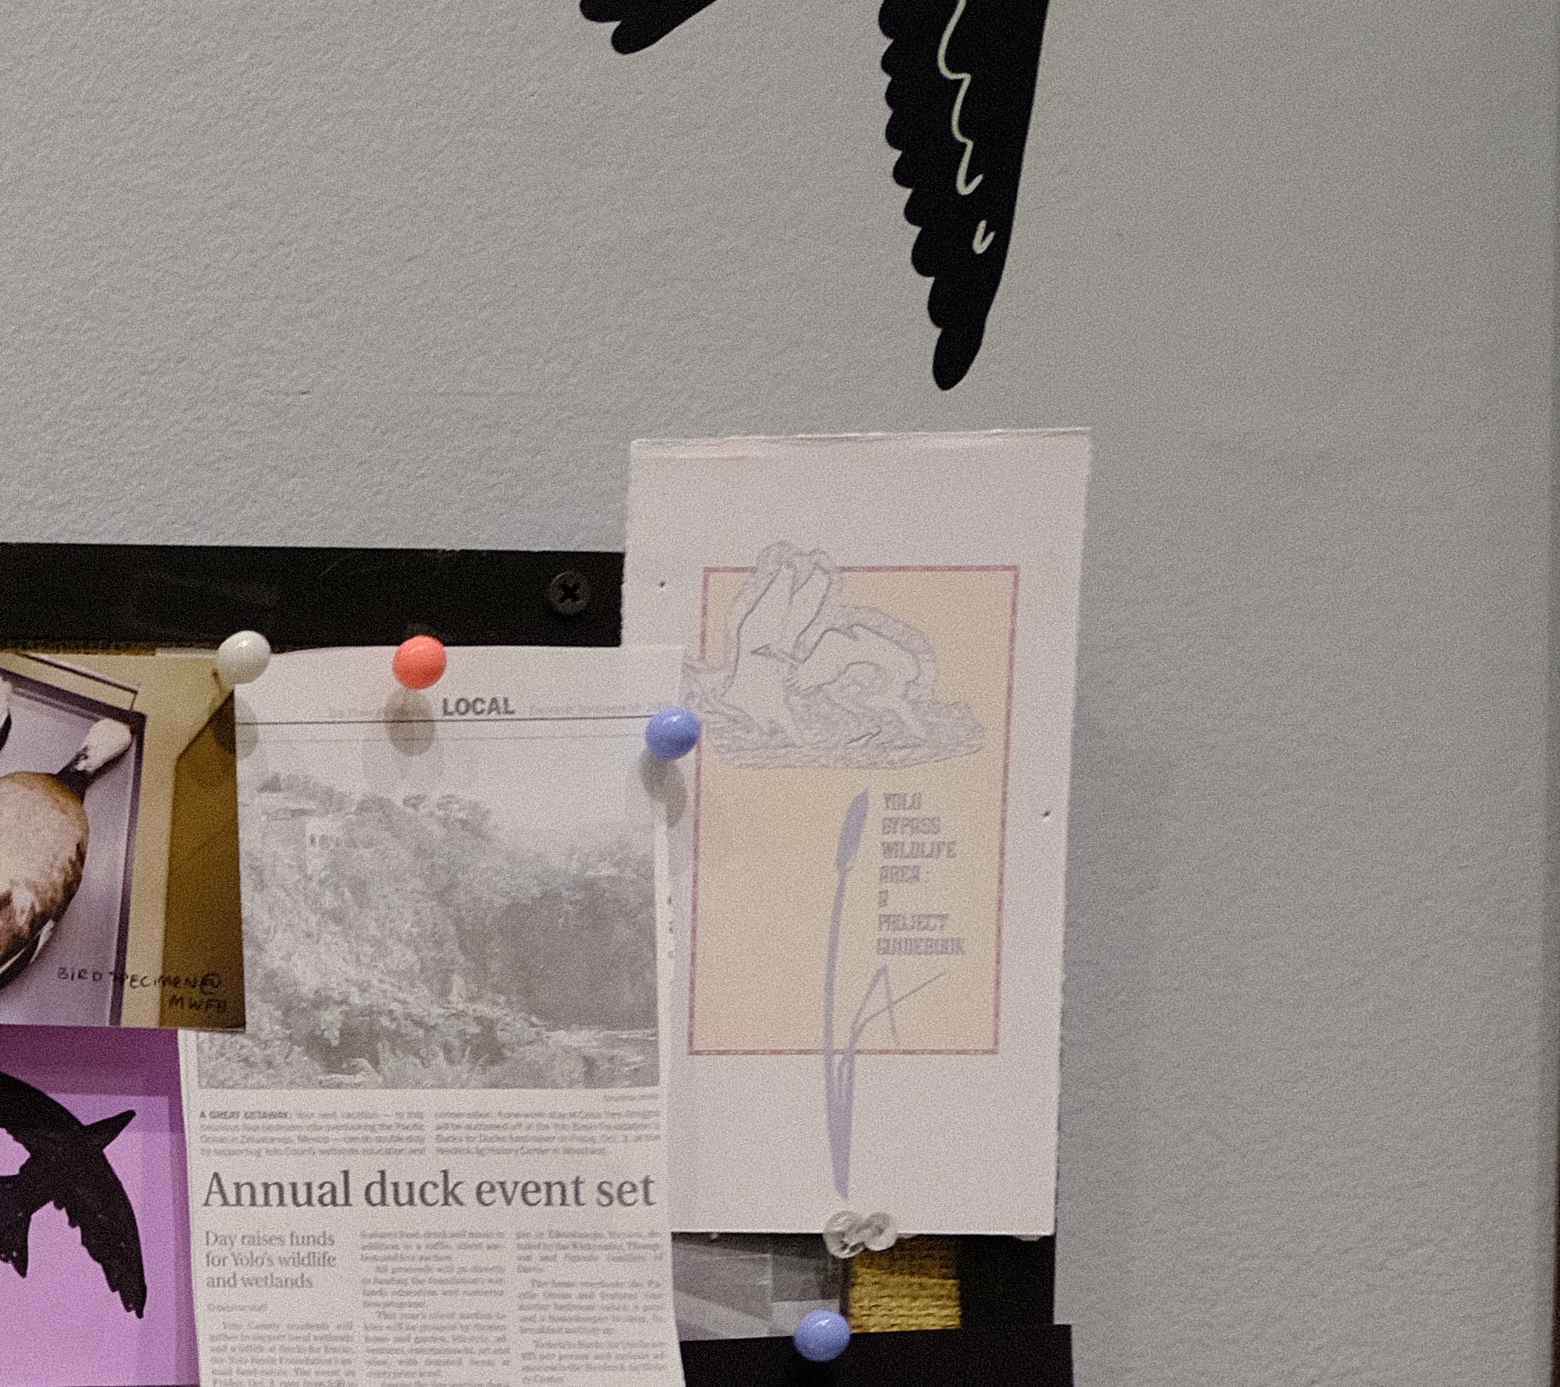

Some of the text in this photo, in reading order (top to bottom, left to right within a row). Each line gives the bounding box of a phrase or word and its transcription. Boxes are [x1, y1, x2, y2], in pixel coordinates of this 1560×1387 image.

[442, 696, 516, 717] LOCAL
[203, 1169, 657, 1208] Annual duck event set
[205, 1230, 335, 1250] Day raises funds
[205, 1251, 337, 1268] for Yolo's wildlife
[207, 1272, 314, 1288] and wetlands
